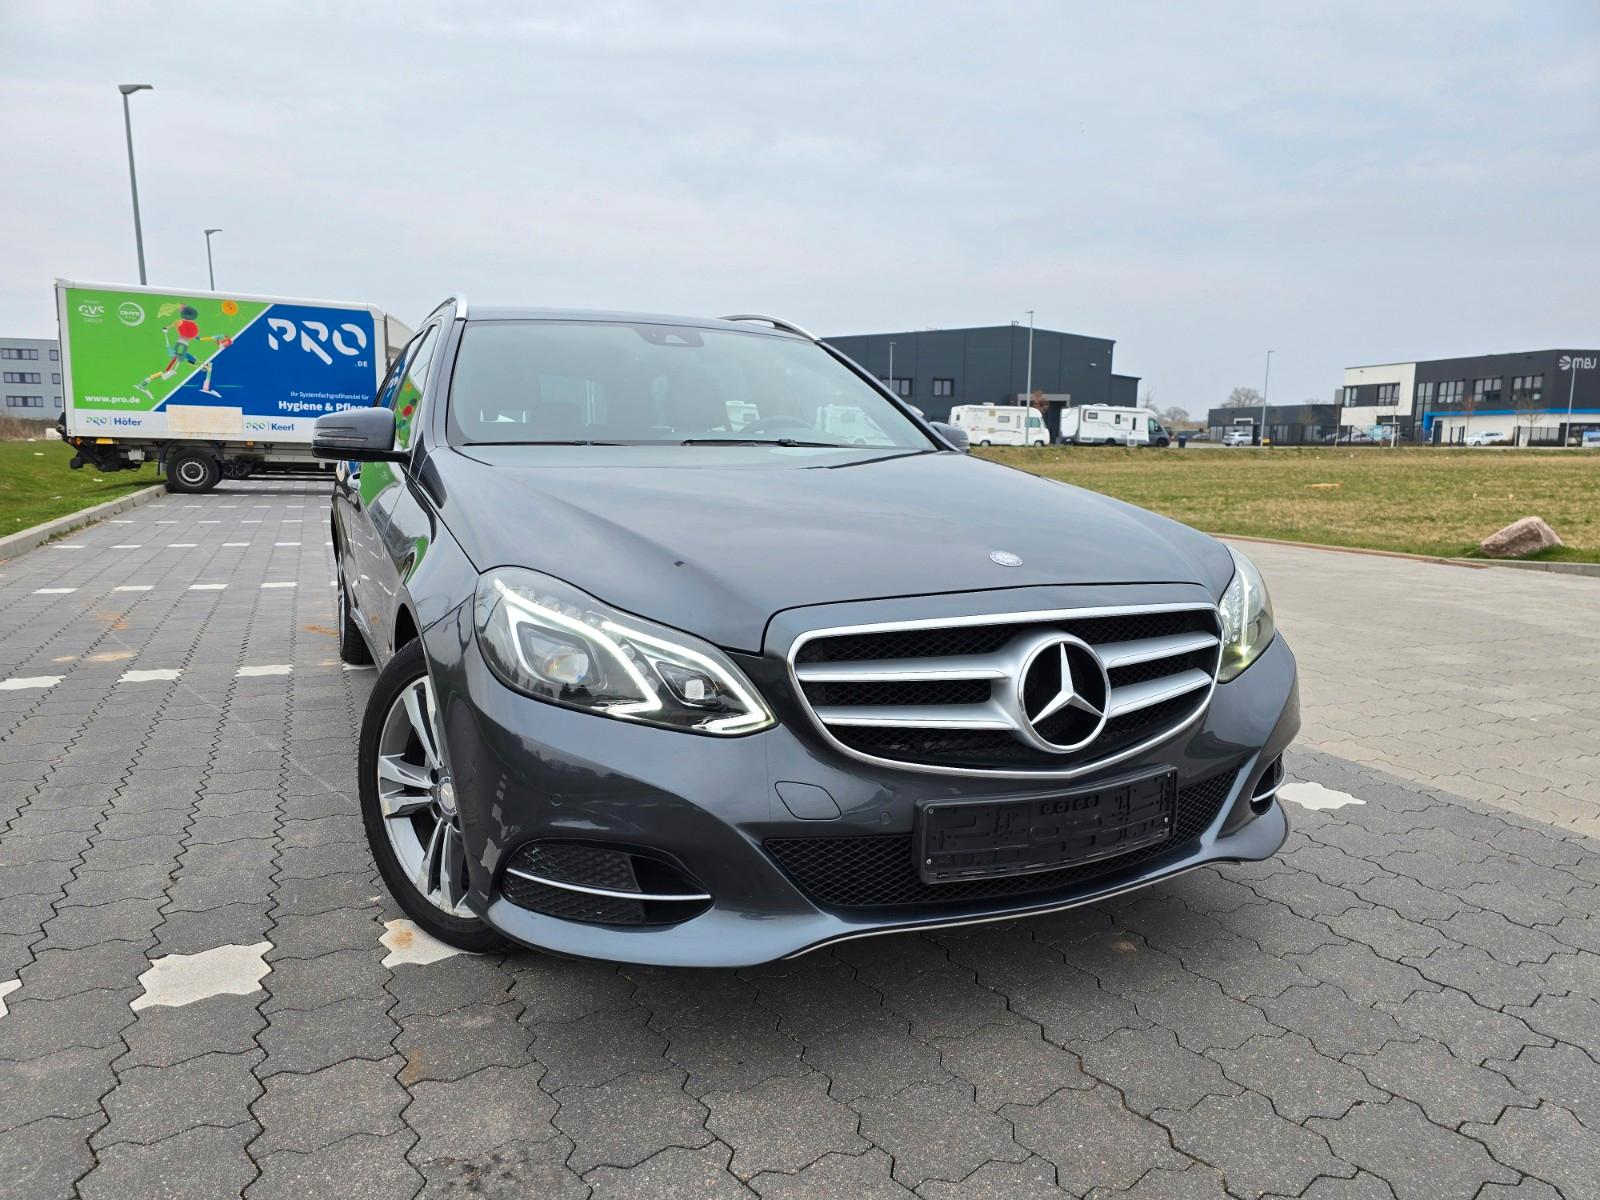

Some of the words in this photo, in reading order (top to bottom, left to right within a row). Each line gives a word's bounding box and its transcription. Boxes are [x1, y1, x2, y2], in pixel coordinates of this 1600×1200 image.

[267, 318, 367, 365] PRO
[1572, 357, 1597, 369] MBJ
[85, 395, 140, 404] www.pro.de
[278, 400, 322, 412] Hygiene
[325, 402, 333, 411] &
[114, 417, 142, 426] Höfer
[271, 423, 294, 431] Keerl
